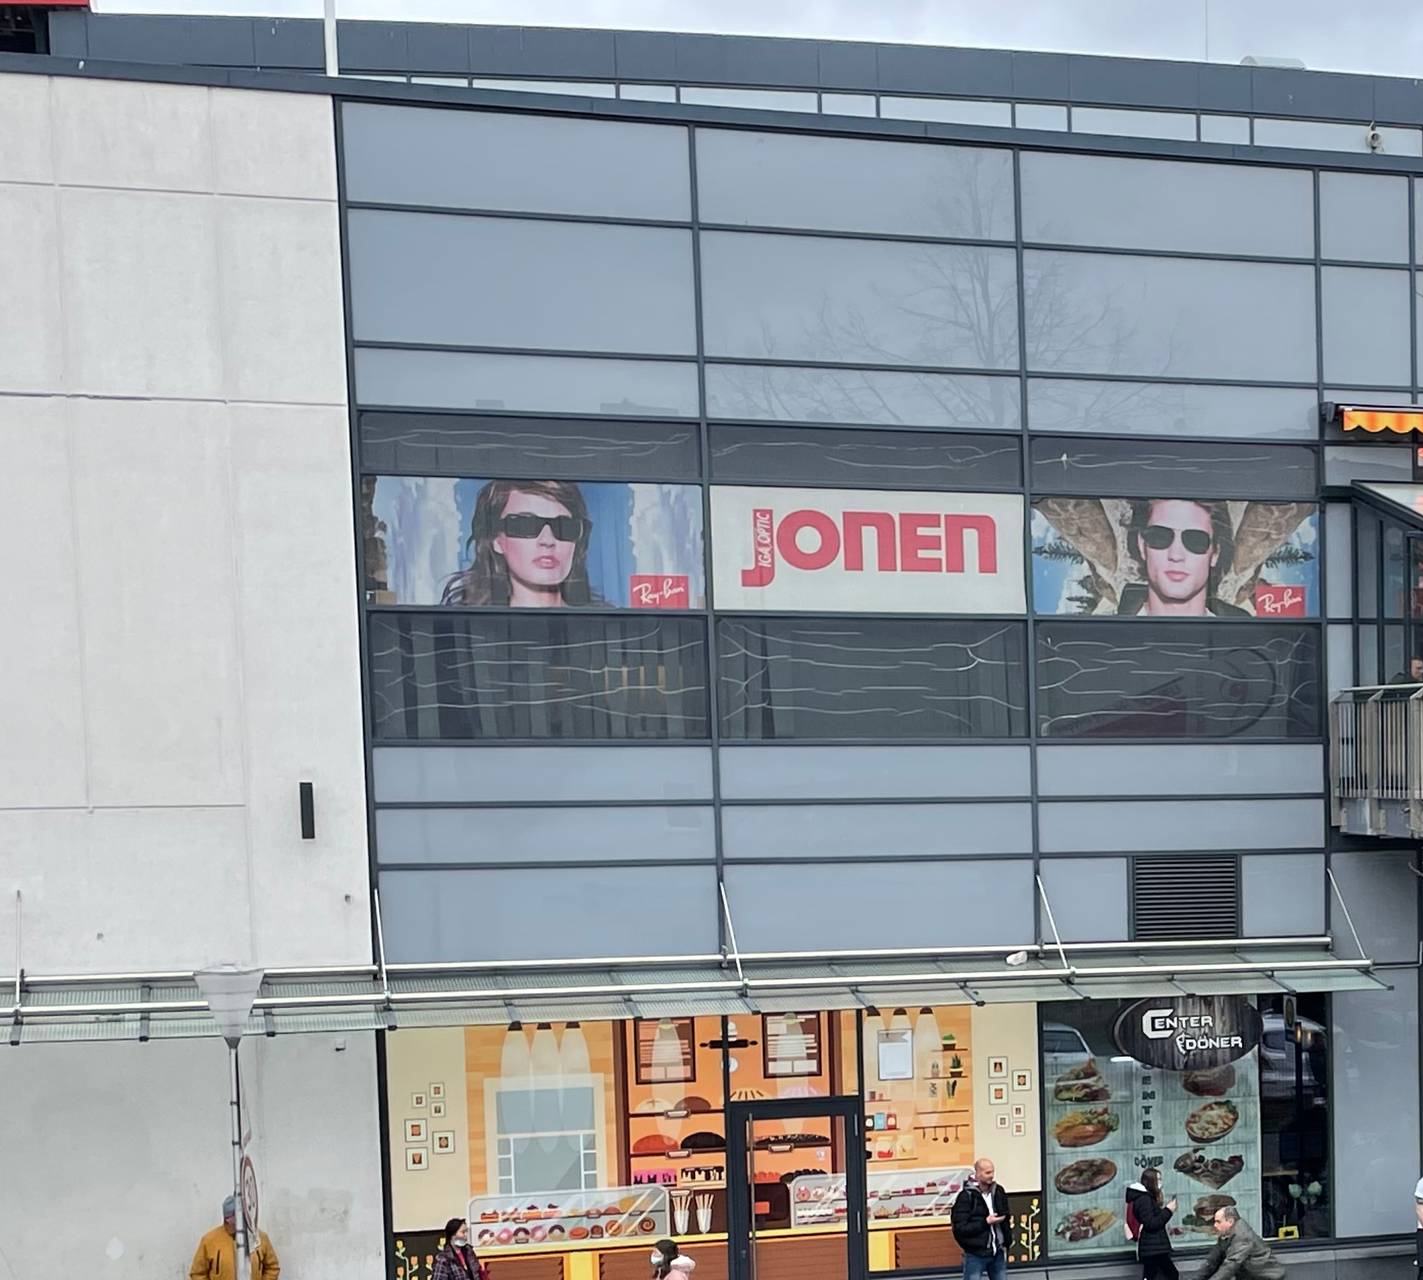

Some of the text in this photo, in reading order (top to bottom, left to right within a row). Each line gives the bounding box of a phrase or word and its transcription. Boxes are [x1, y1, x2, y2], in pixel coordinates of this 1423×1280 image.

[757, 511, 772, 568] IGA OPTIC
[1142, 1008, 1214, 1039] CENTER
[1185, 1033, 1243, 1051] DÖNER
